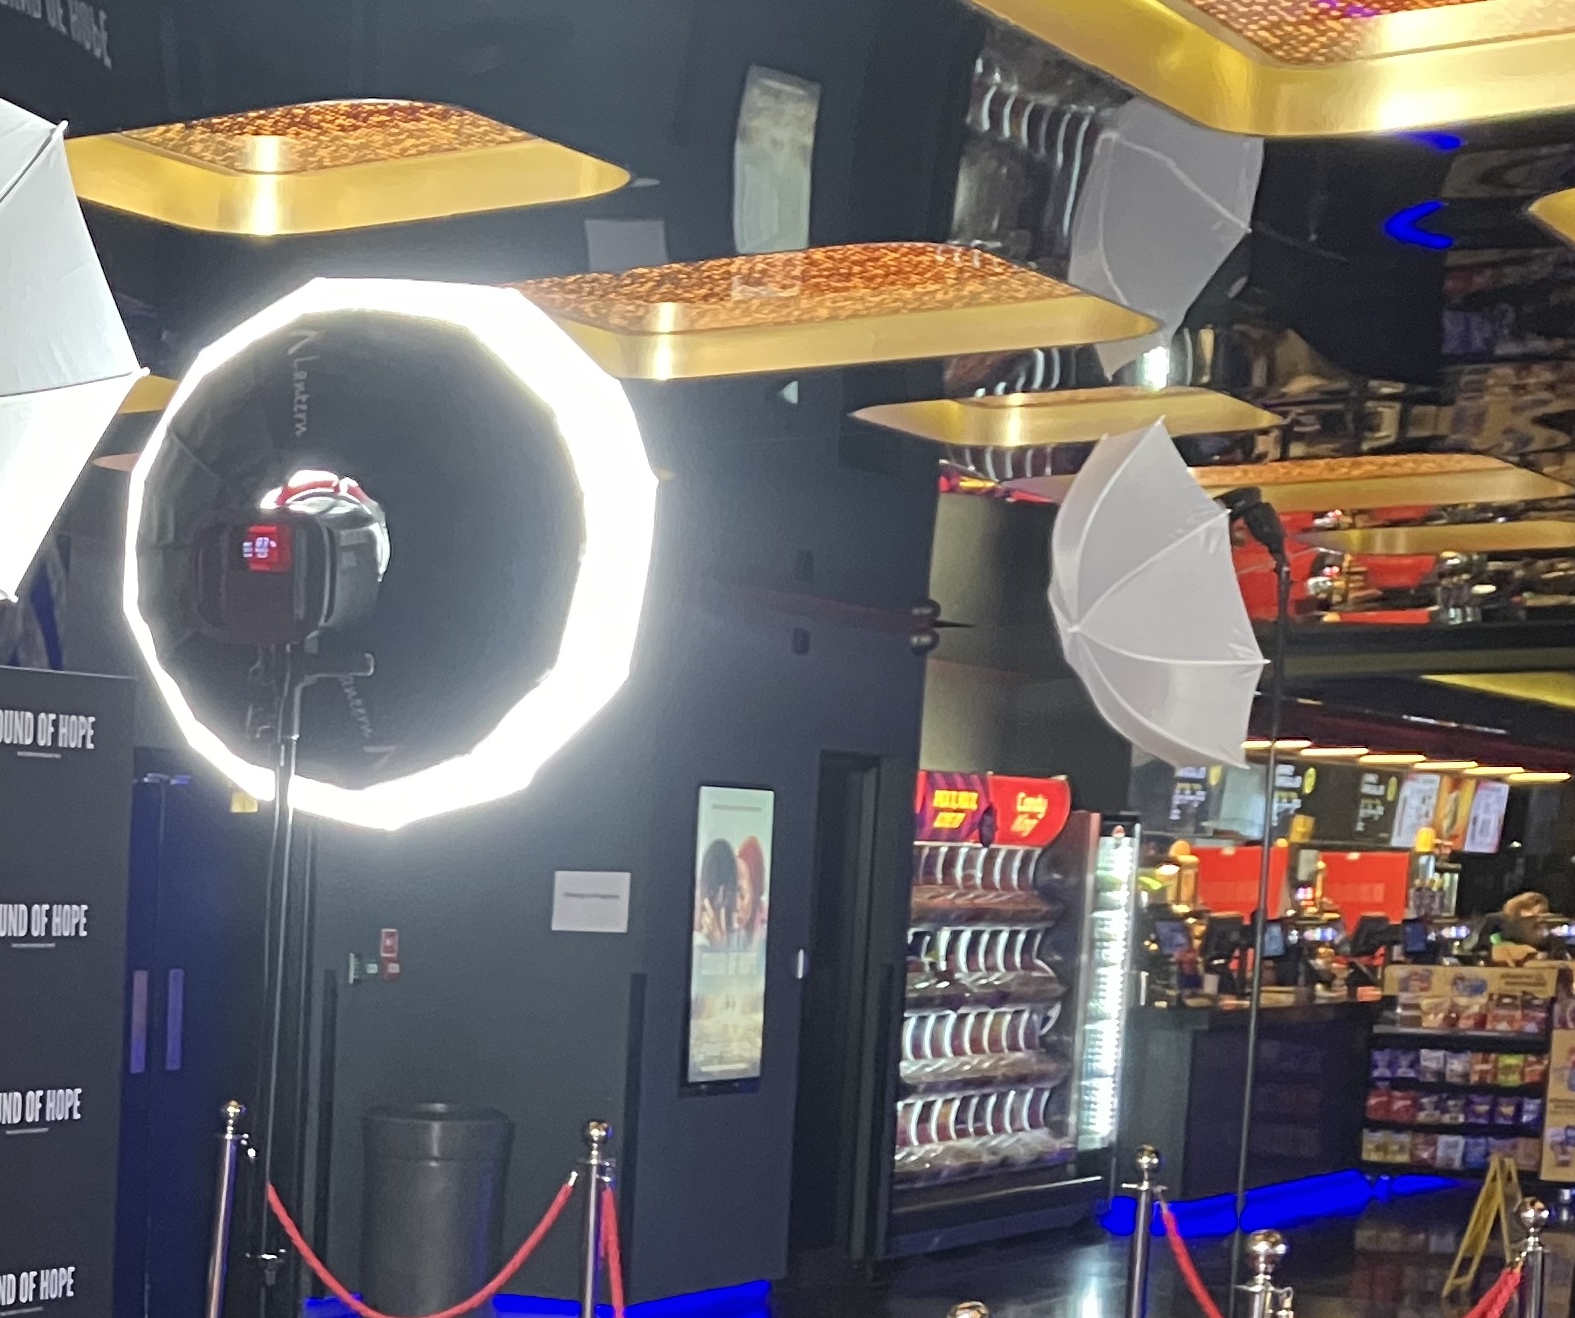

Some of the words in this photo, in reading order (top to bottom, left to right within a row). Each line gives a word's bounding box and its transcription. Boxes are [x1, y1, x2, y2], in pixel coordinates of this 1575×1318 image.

[292, 355, 320, 438] Lantern
[38, 712, 57, 747] OF
[59, 715, 96, 750] HOPE
[31, 903, 50, 937] OF
[52, 904, 89, 937] HOPE
[26, 1089, 44, 1123] OF
[46, 1087, 83, 1122] HOPE
[20, 1270, 38, 1304] OF
[40, 1266, 76, 1300] HOPE
